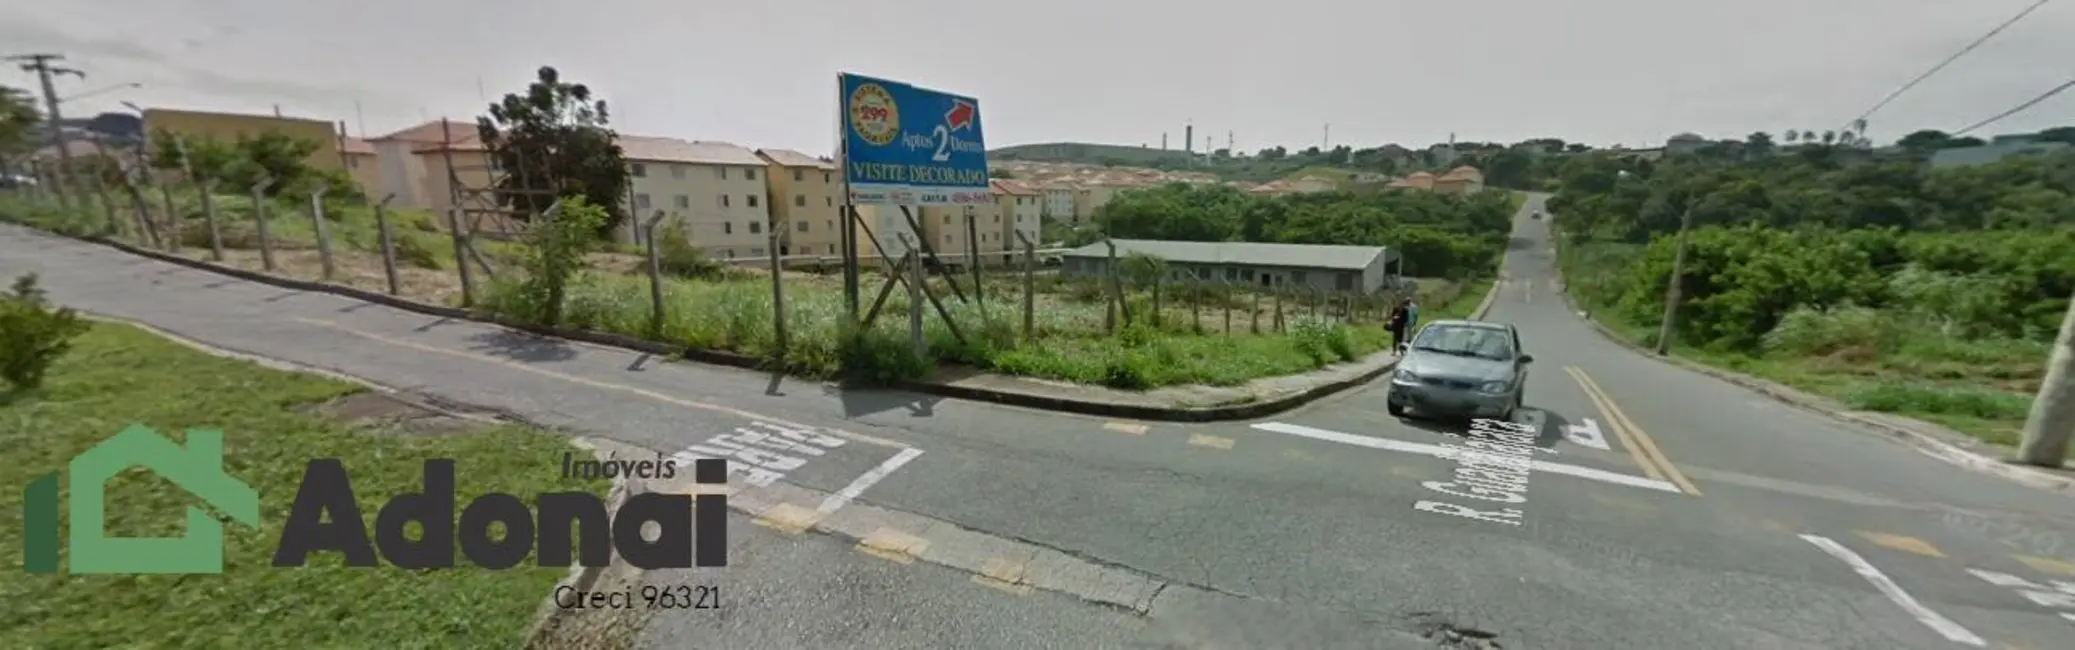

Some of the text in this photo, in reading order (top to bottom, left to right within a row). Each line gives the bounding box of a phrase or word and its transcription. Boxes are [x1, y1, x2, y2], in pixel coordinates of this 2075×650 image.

[860, 104, 888, 121] 299
[932, 124, 951, 161] 2
[852, 161, 985, 185] VISITE DECORADO
